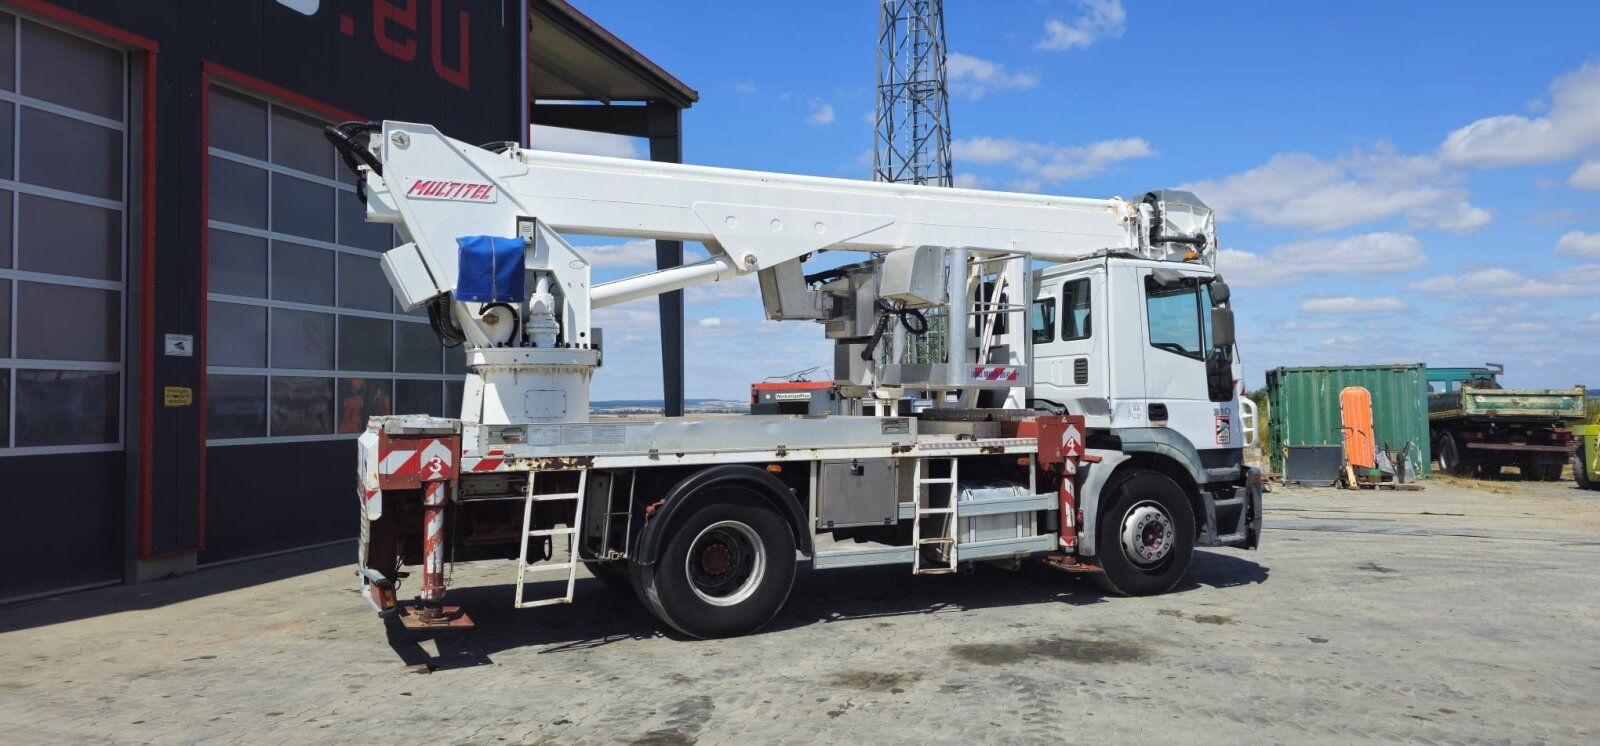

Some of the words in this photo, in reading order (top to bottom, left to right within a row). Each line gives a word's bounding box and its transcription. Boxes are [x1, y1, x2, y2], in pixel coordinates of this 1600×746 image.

[406, 179, 494, 200] MULTITEL
[1067, 437, 1075, 450] 4
[429, 457, 442, 472] 3
